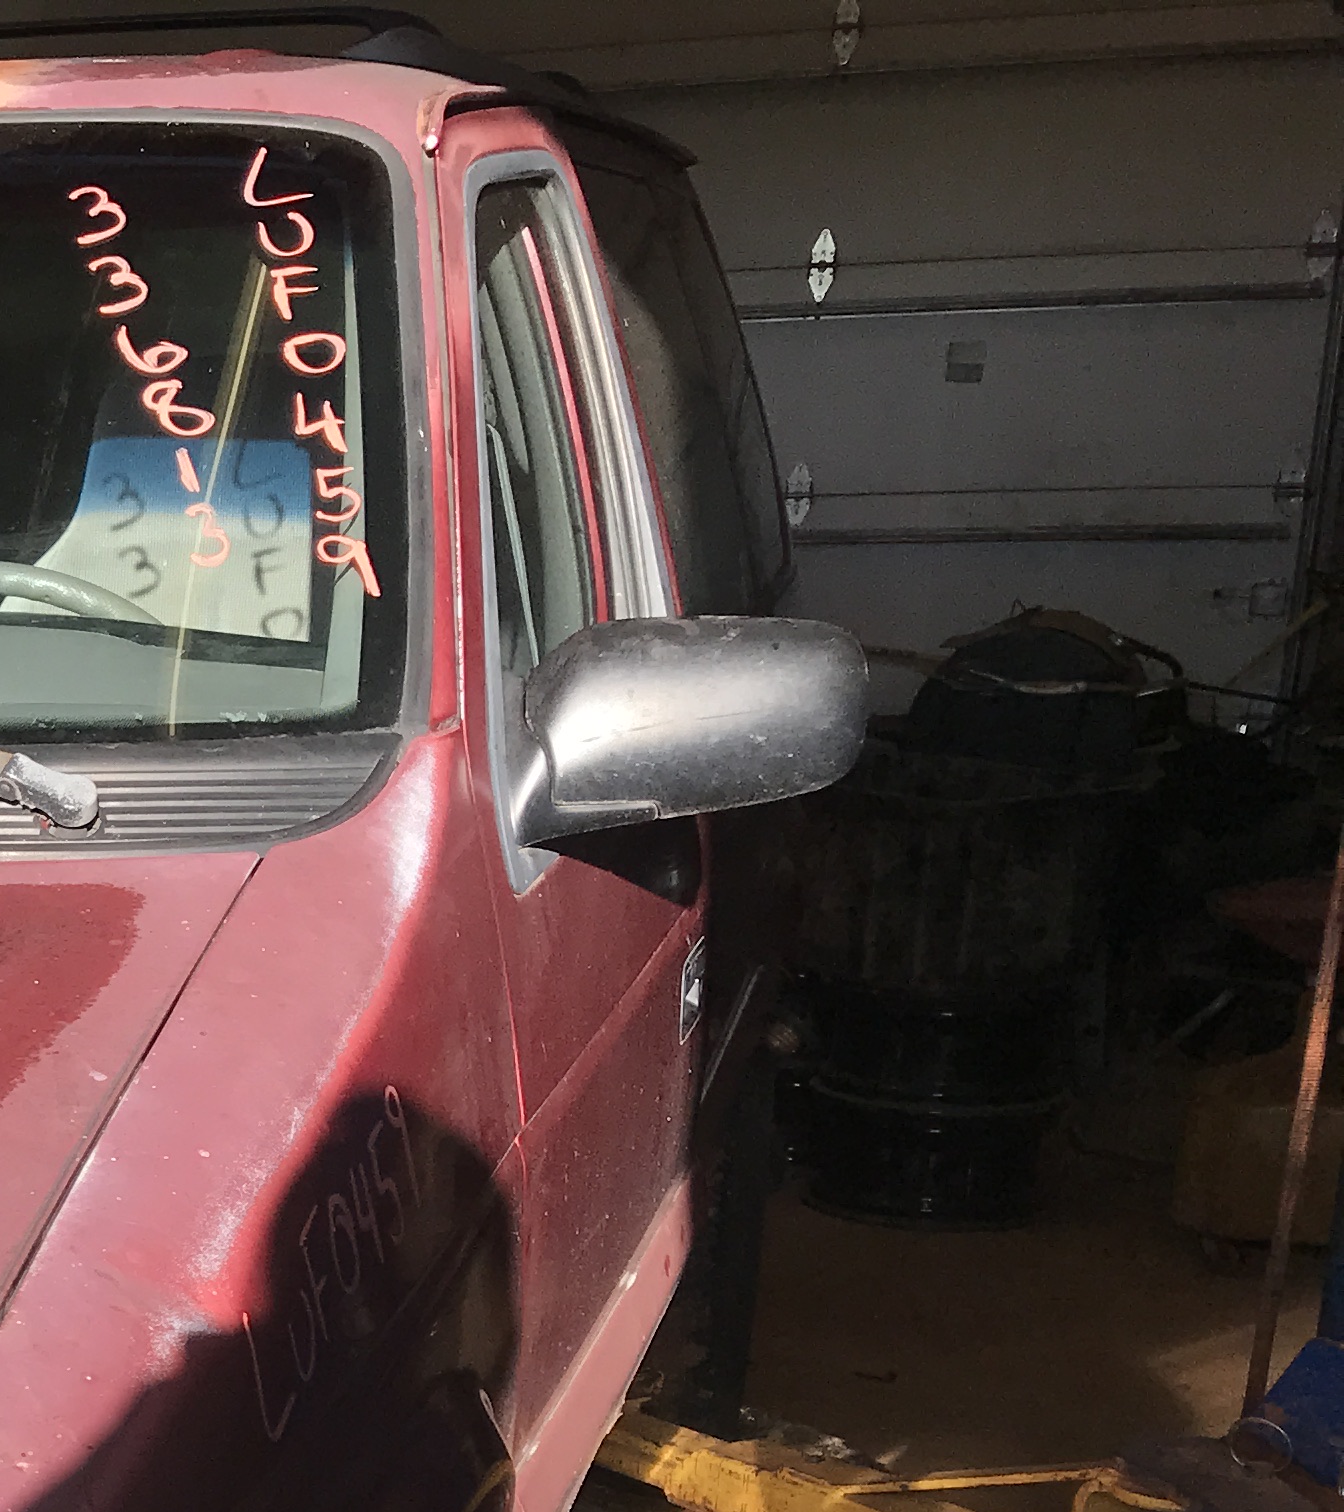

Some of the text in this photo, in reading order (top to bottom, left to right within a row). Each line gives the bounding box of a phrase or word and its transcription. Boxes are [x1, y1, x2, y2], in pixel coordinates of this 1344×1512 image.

[67, 185, 232, 568] 336813
[242, 146, 381, 598] LUF0459
[241, 1083, 422, 1443] LUF0459
